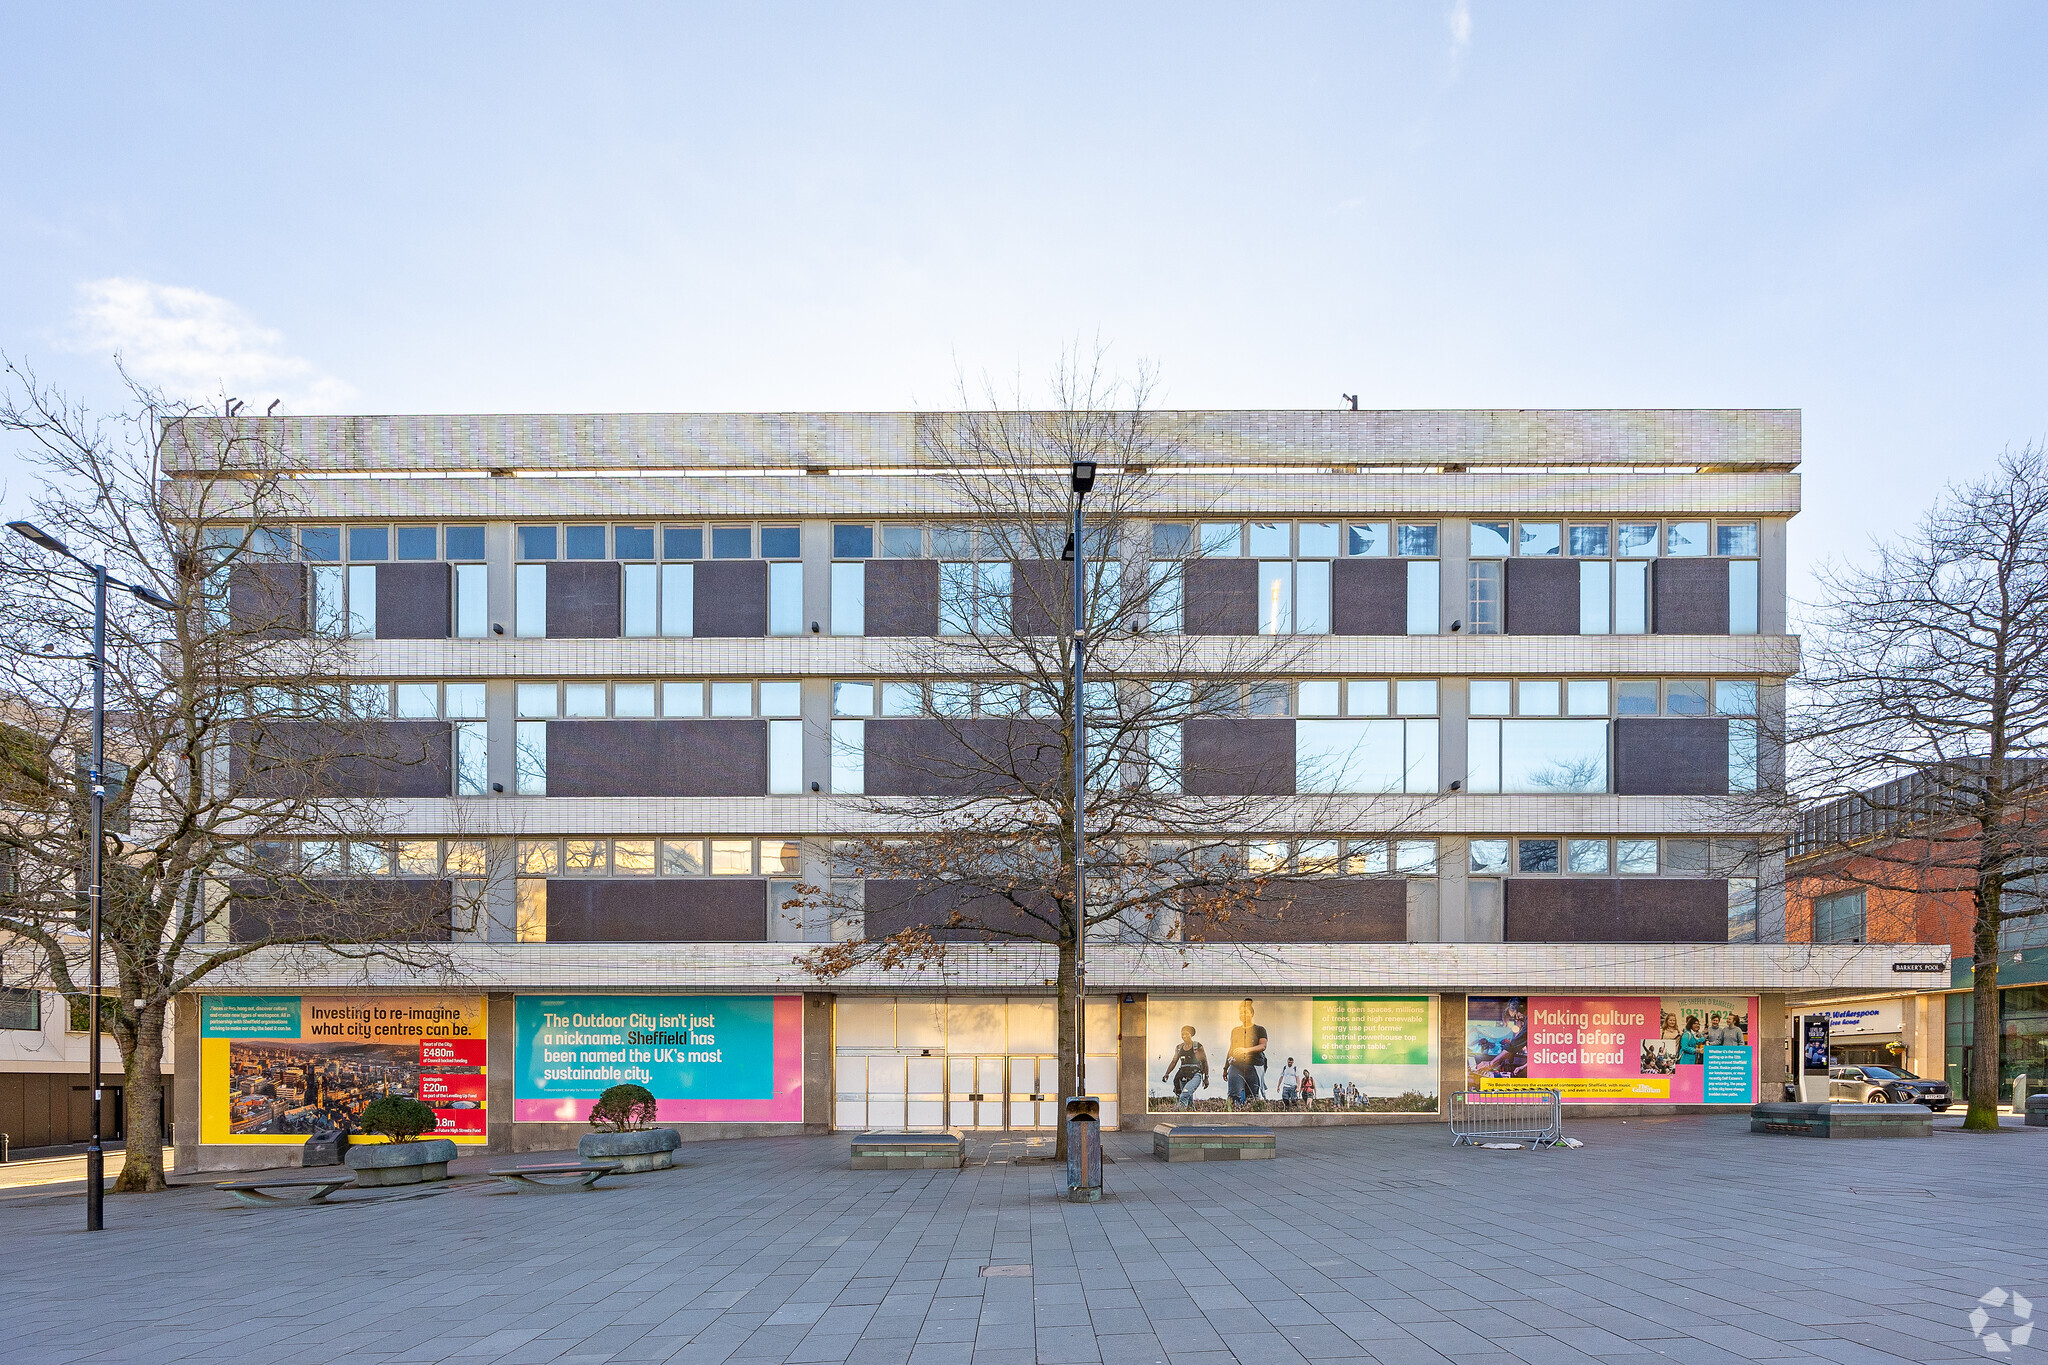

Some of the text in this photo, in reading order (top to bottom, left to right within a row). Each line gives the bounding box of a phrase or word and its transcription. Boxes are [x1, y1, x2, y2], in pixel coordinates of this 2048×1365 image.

[1688, 997, 1712, 1005] SHEFFIED
[312, 1006, 460, 1023] Investing to re-imagine
[1367, 1015, 1383, 1023] high
[1534, 1010, 1644, 1029] Making culture
[1681, 1008, 1704, 1019] 1951
[1833, 1010, 1880, 1018] Wetherspoon
[544, 1014, 715, 1032] The Outdoor City isn't just
[312, 1023, 471, 1038] what city centres can be.
[1534, 1029, 1625, 1045] since before
[544, 1031, 715, 1045] a nickname. Sheffield has
[424, 1048, 454, 1057] £480m
[544, 1049, 722, 1062] been named the UK's most
[1534, 1049, 1624, 1064] sliced bread
[544, 1066, 653, 1084] sustainable city.
[423, 1083, 448, 1092] £20m
